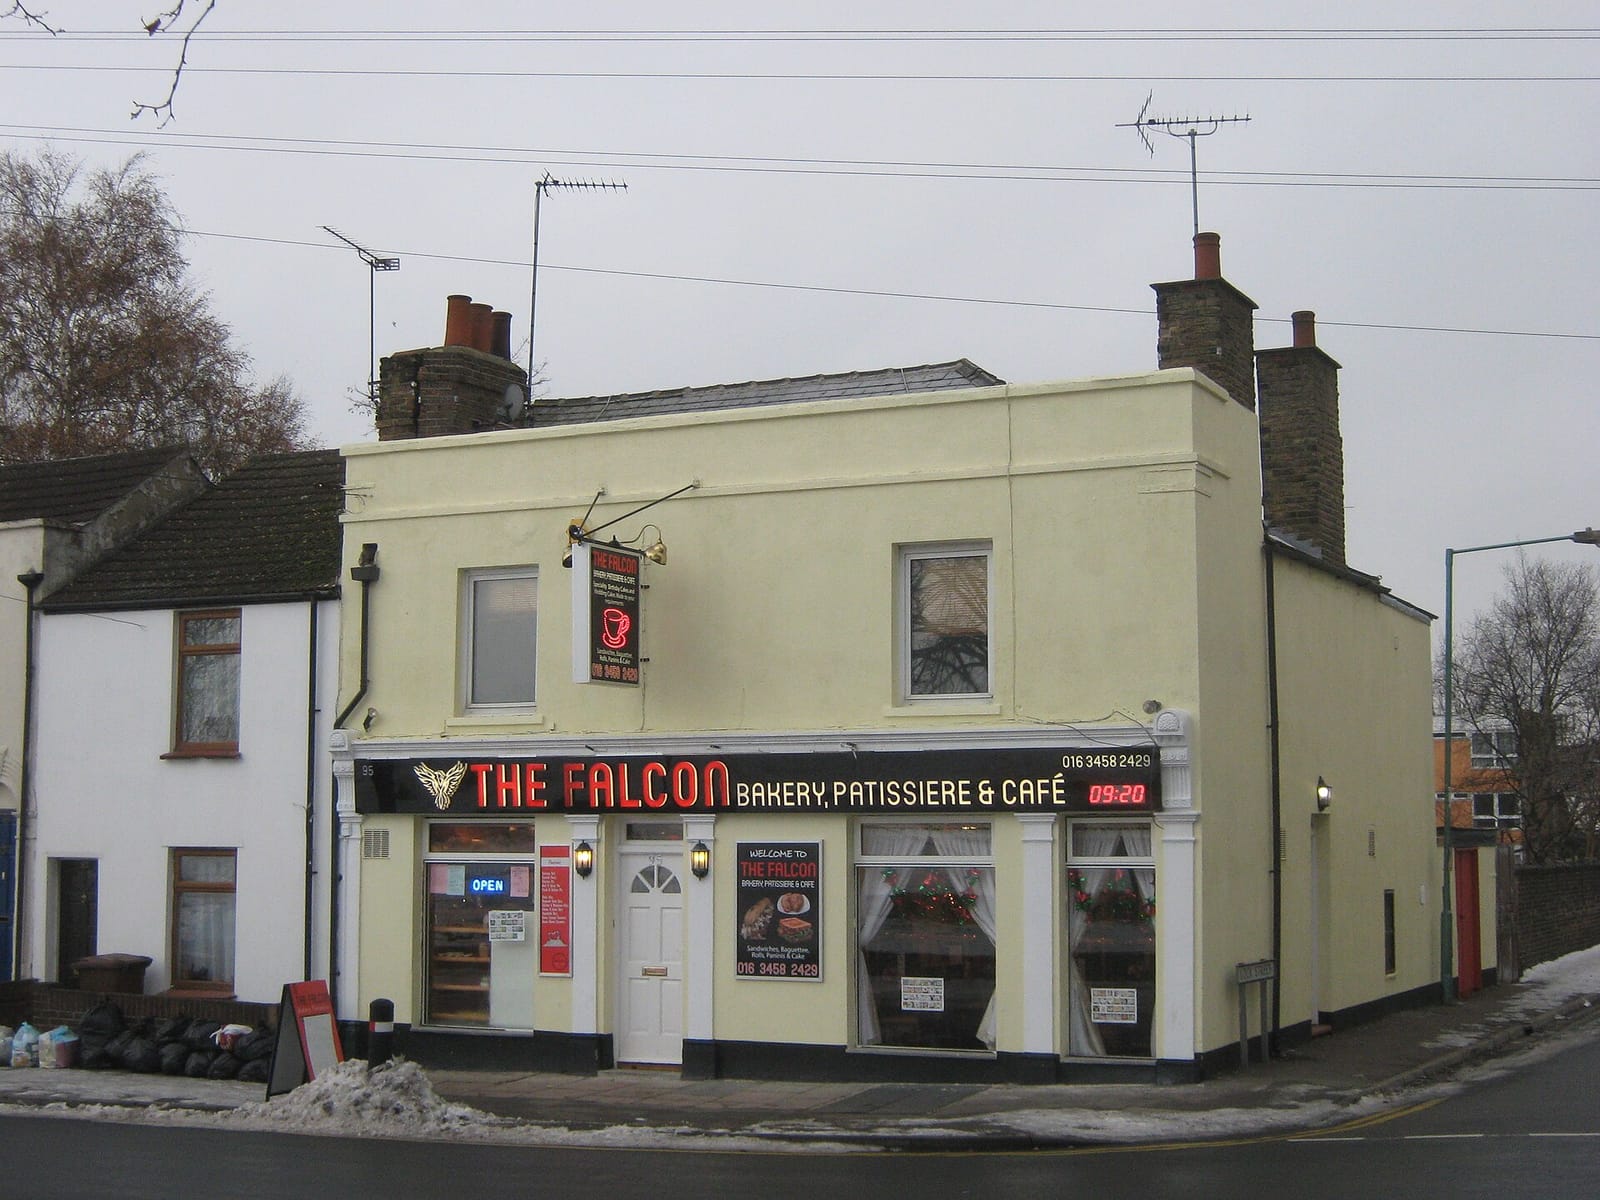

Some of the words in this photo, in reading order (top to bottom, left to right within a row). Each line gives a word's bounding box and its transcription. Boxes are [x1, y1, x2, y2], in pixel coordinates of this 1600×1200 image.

[592, 551, 607, 569] THE
[608, 554, 637, 576] FALCON
[1062, 755, 1083, 768] 016
[1086, 755, 1117, 768] 3458
[1119, 754, 1151, 767] 2429
[362, 765, 374, 776] 95
[471, 763, 548, 807] THE
[564, 761, 730, 807] FALCON
[737, 782, 828, 808] BAKERY,
[834, 781, 971, 805] PATISSIERE
[979, 781, 995, 804] &
[1003, 773, 1066, 804] CAFÉ
[1089, 784, 1146, 804] 09:20
[749, 849, 793, 858] WELCOME
[794, 849, 807, 858] TO
[741, 862, 764, 877] THE
[768, 862, 816, 877] FALCON
[473, 880, 503, 891] OPEN
[737, 962, 755, 974] 016
[759, 962, 787, 975] 3458
[791, 963, 818, 976] 2429
